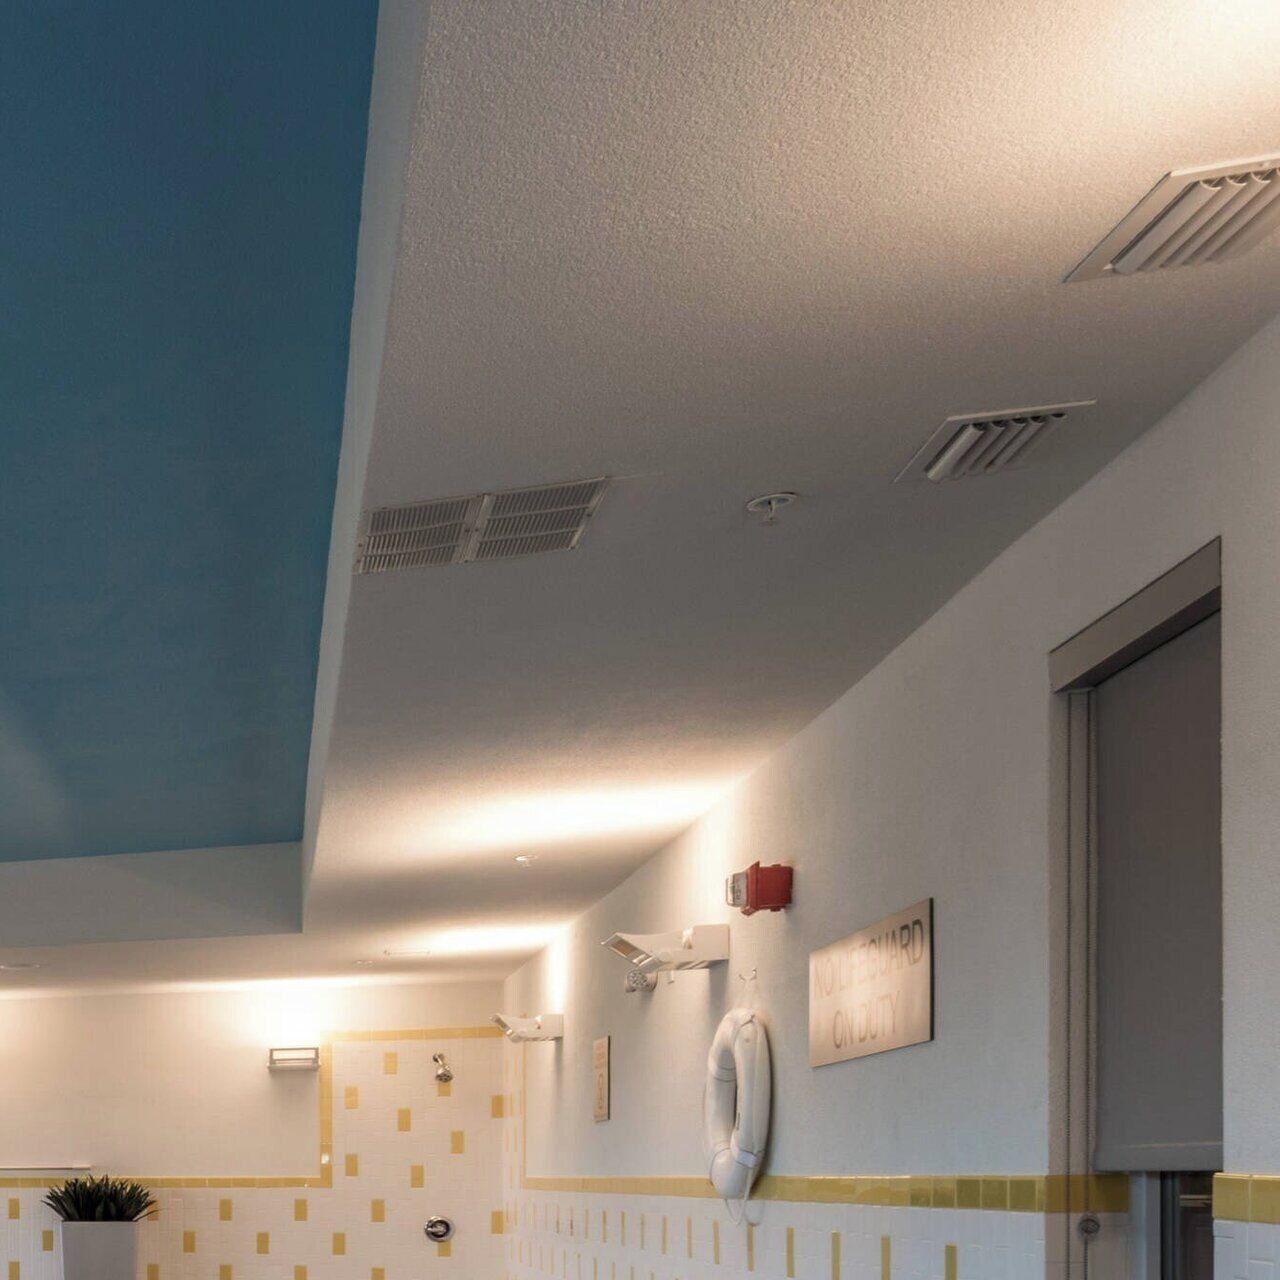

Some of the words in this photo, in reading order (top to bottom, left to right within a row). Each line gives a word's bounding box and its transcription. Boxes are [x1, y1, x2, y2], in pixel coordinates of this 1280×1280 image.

[814, 957, 834, 999] NO
[839, 918, 924, 991] LIFEGUARD
[832, 1009, 854, 1049] ON
[858, 990, 901, 1043] DUTY
